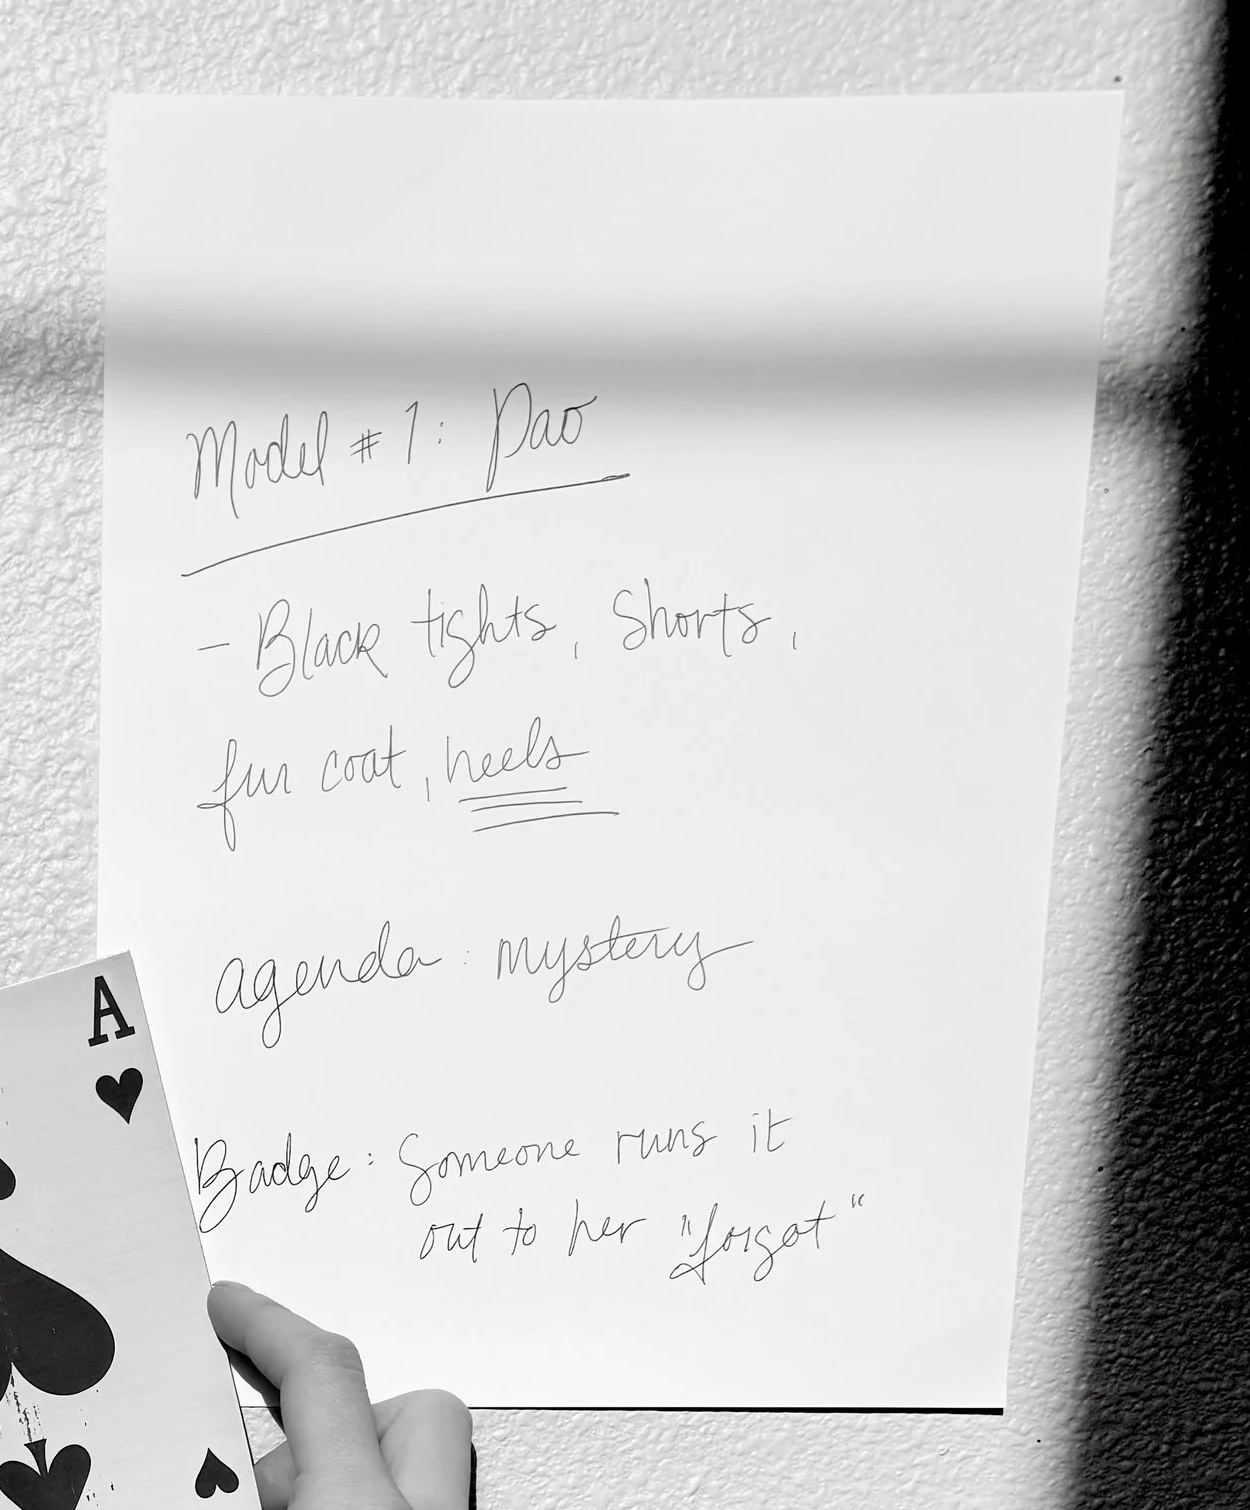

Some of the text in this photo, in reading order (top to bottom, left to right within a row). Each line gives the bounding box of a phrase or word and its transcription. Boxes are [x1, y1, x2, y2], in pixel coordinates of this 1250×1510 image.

[186, 411, 329, 520] Model
[486, 383, 598, 493] Pao
[256, 599, 389, 697] Black
[197, 739, 292, 852] fur
[447, 716, 590, 784] heels
[88, 976, 135, 1047] A
[194, 1132, 375, 1234] Badge:
[617, 1119, 718, 1164] runs
[752, 1109, 793, 1154] it
[420, 1213, 483, 1263] out
[510, 1208, 537, 1256] to
[568, 1199, 648, 1257] her
